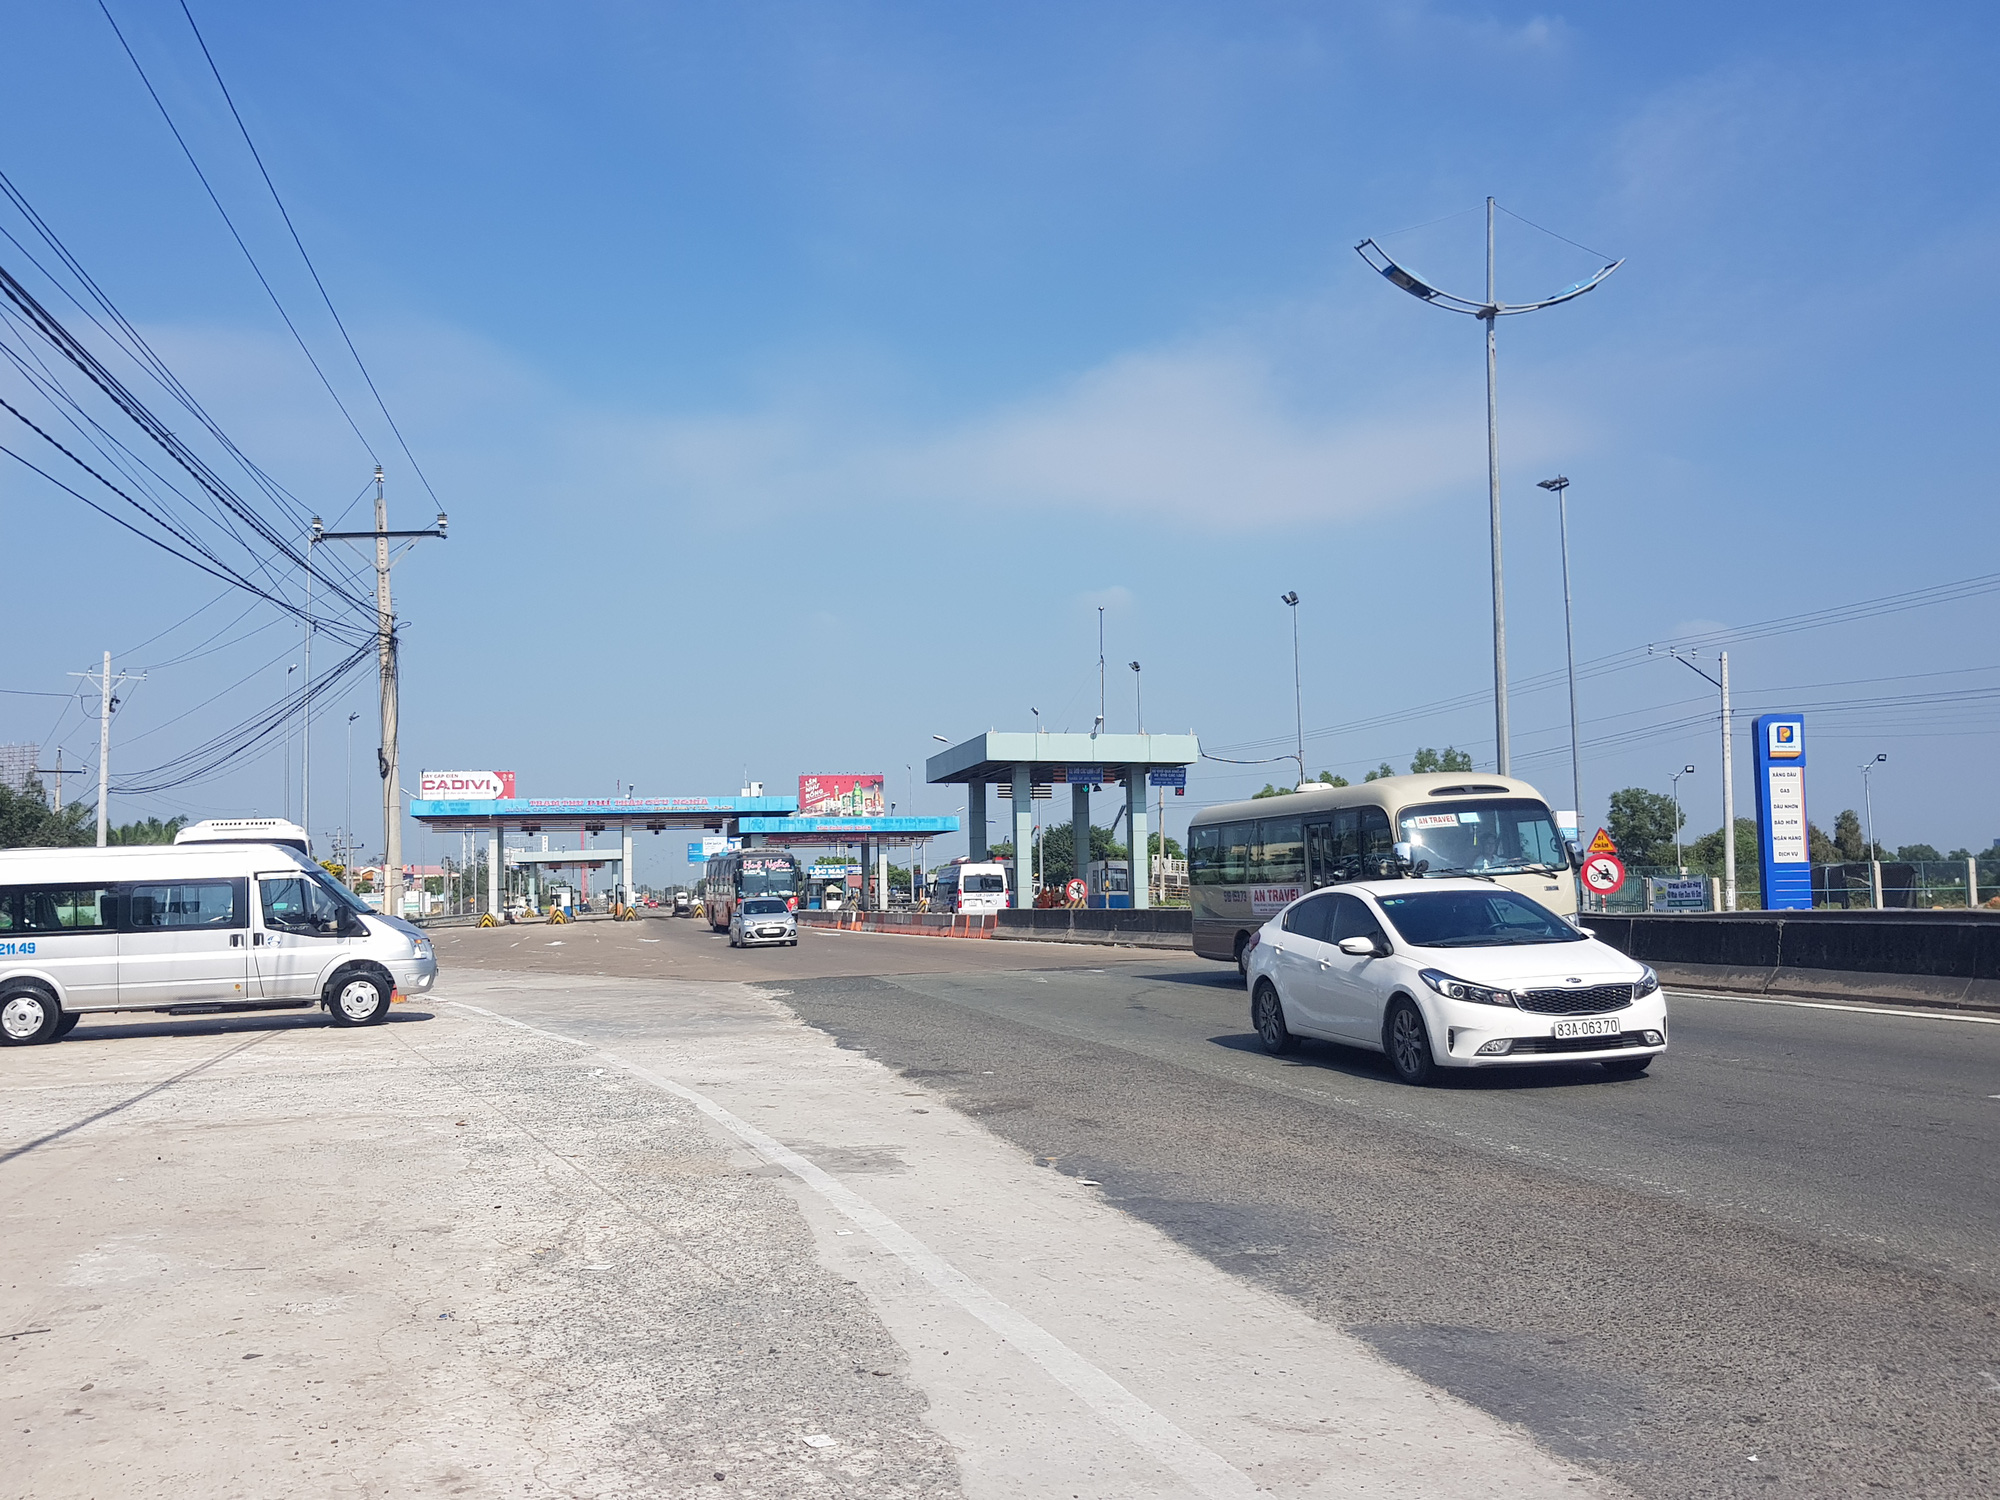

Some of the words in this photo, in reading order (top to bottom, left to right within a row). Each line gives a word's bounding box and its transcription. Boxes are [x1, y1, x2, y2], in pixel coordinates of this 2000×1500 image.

[422, 779, 490, 790] CADIVI
[587, 798, 611, 806] PHÍ
[1254, 890, 1266, 902] AN
[1267, 889, 1299, 902] TRAVEL
[1557, 1020, 1618, 1036] 83A-063.70
